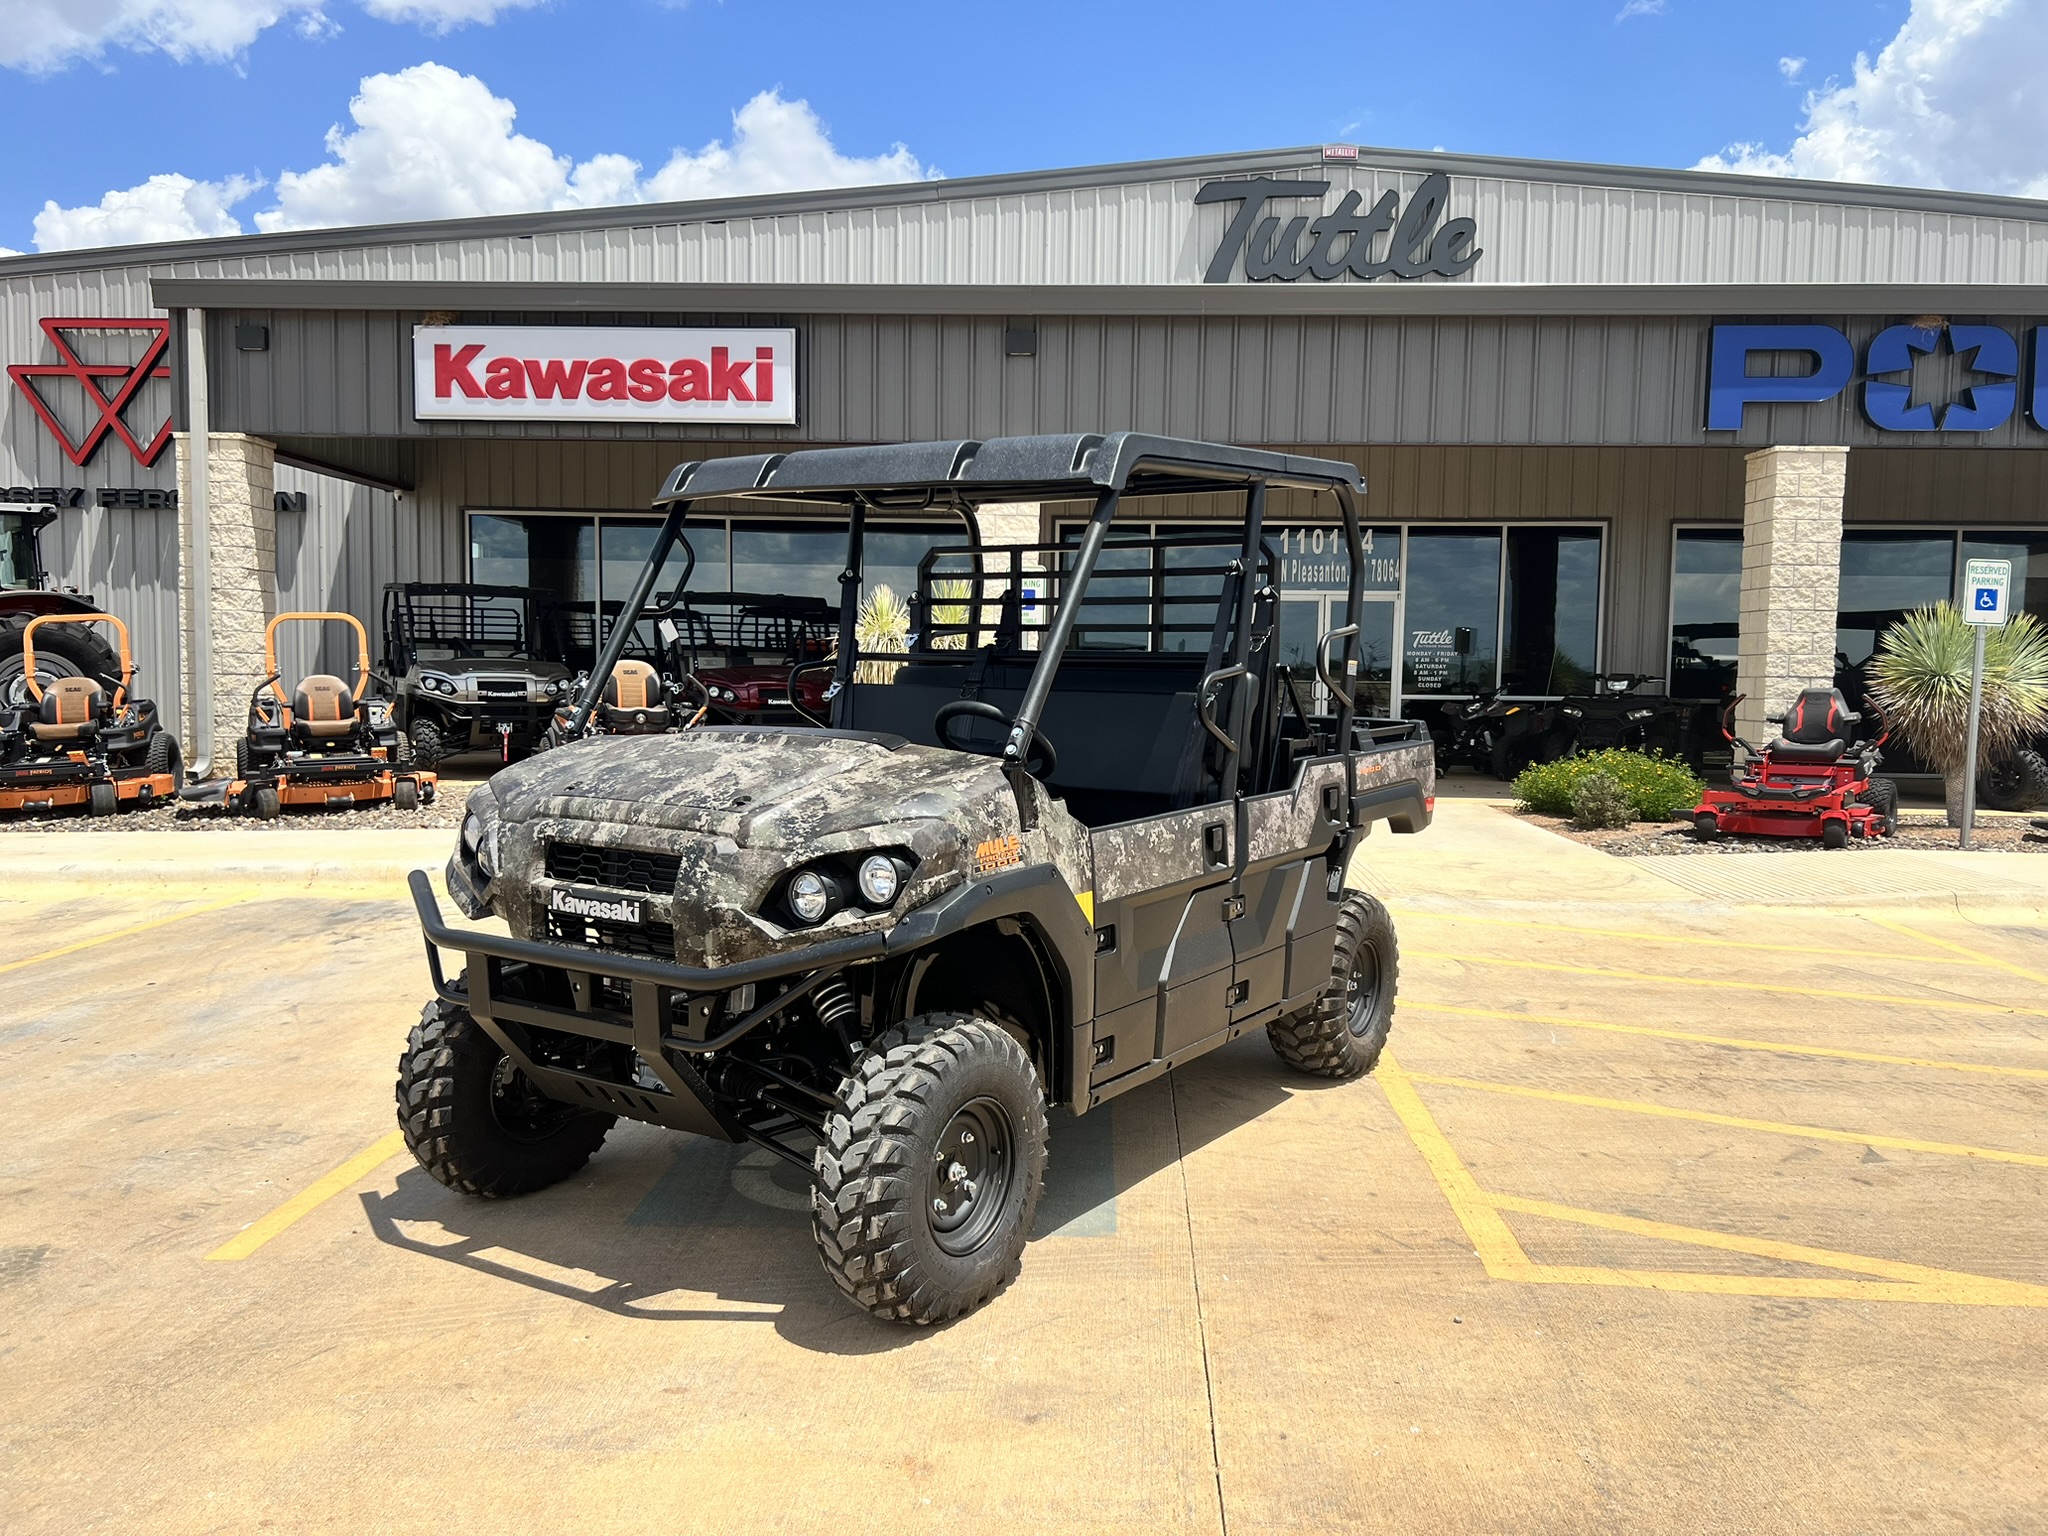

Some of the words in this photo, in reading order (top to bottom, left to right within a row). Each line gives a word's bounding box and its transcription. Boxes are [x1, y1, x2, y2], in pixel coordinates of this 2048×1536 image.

[1326, 148, 1356, 156] METALLIC
[1195, 172, 1483, 283] Tuttle
[434, 343, 773, 402] Kawasaki
[1371, 559, 1399, 582] 78064
[1970, 566, 2007, 575] RESERVED
[1972, 577, 2004, 586] PARKING
[1412, 629, 1453, 648] Tuttle
[975, 835, 1021, 858] MULE
[980, 856, 1019, 871] 1000
[552, 889, 640, 922] Kawasaki
